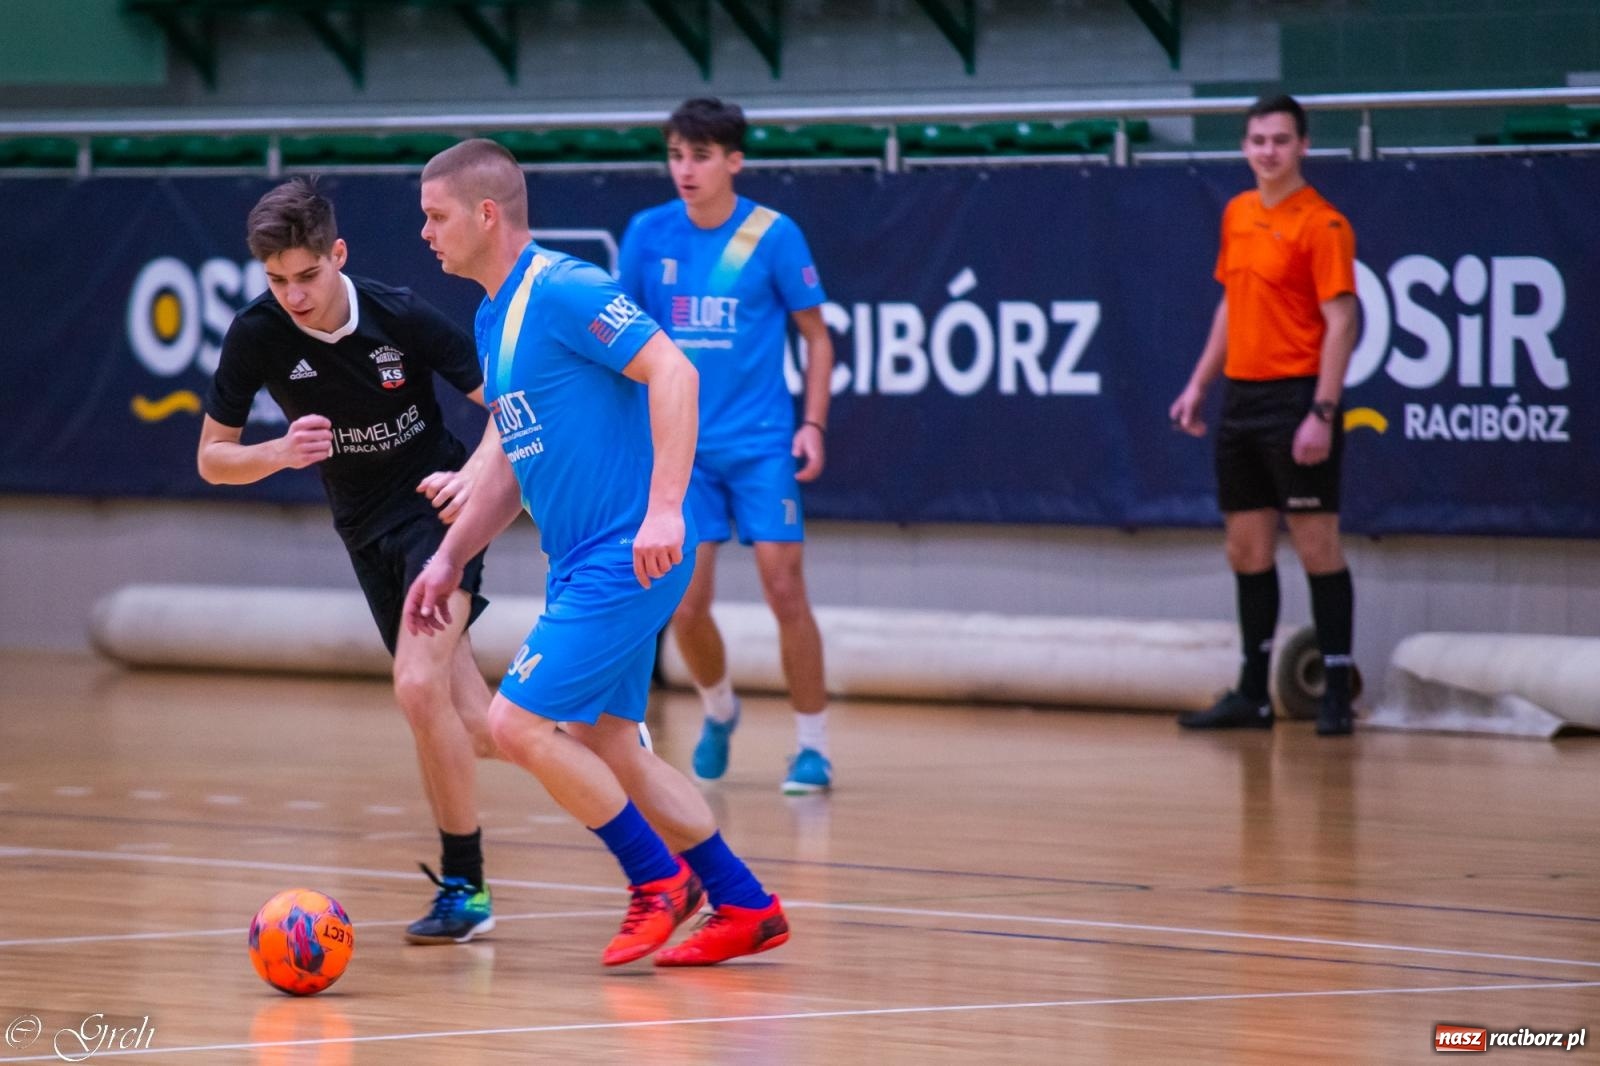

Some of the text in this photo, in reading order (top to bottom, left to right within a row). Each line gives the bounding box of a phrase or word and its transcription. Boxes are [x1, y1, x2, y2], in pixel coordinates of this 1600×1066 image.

[690, 296, 740, 327] LOFT
[290, 370, 318, 380] adidas
[381, 369, 403, 381] KS
[1404, 393, 1570, 441] RACIBÓRZ
[343, 420, 426, 454] PRACA W AUSTRII
